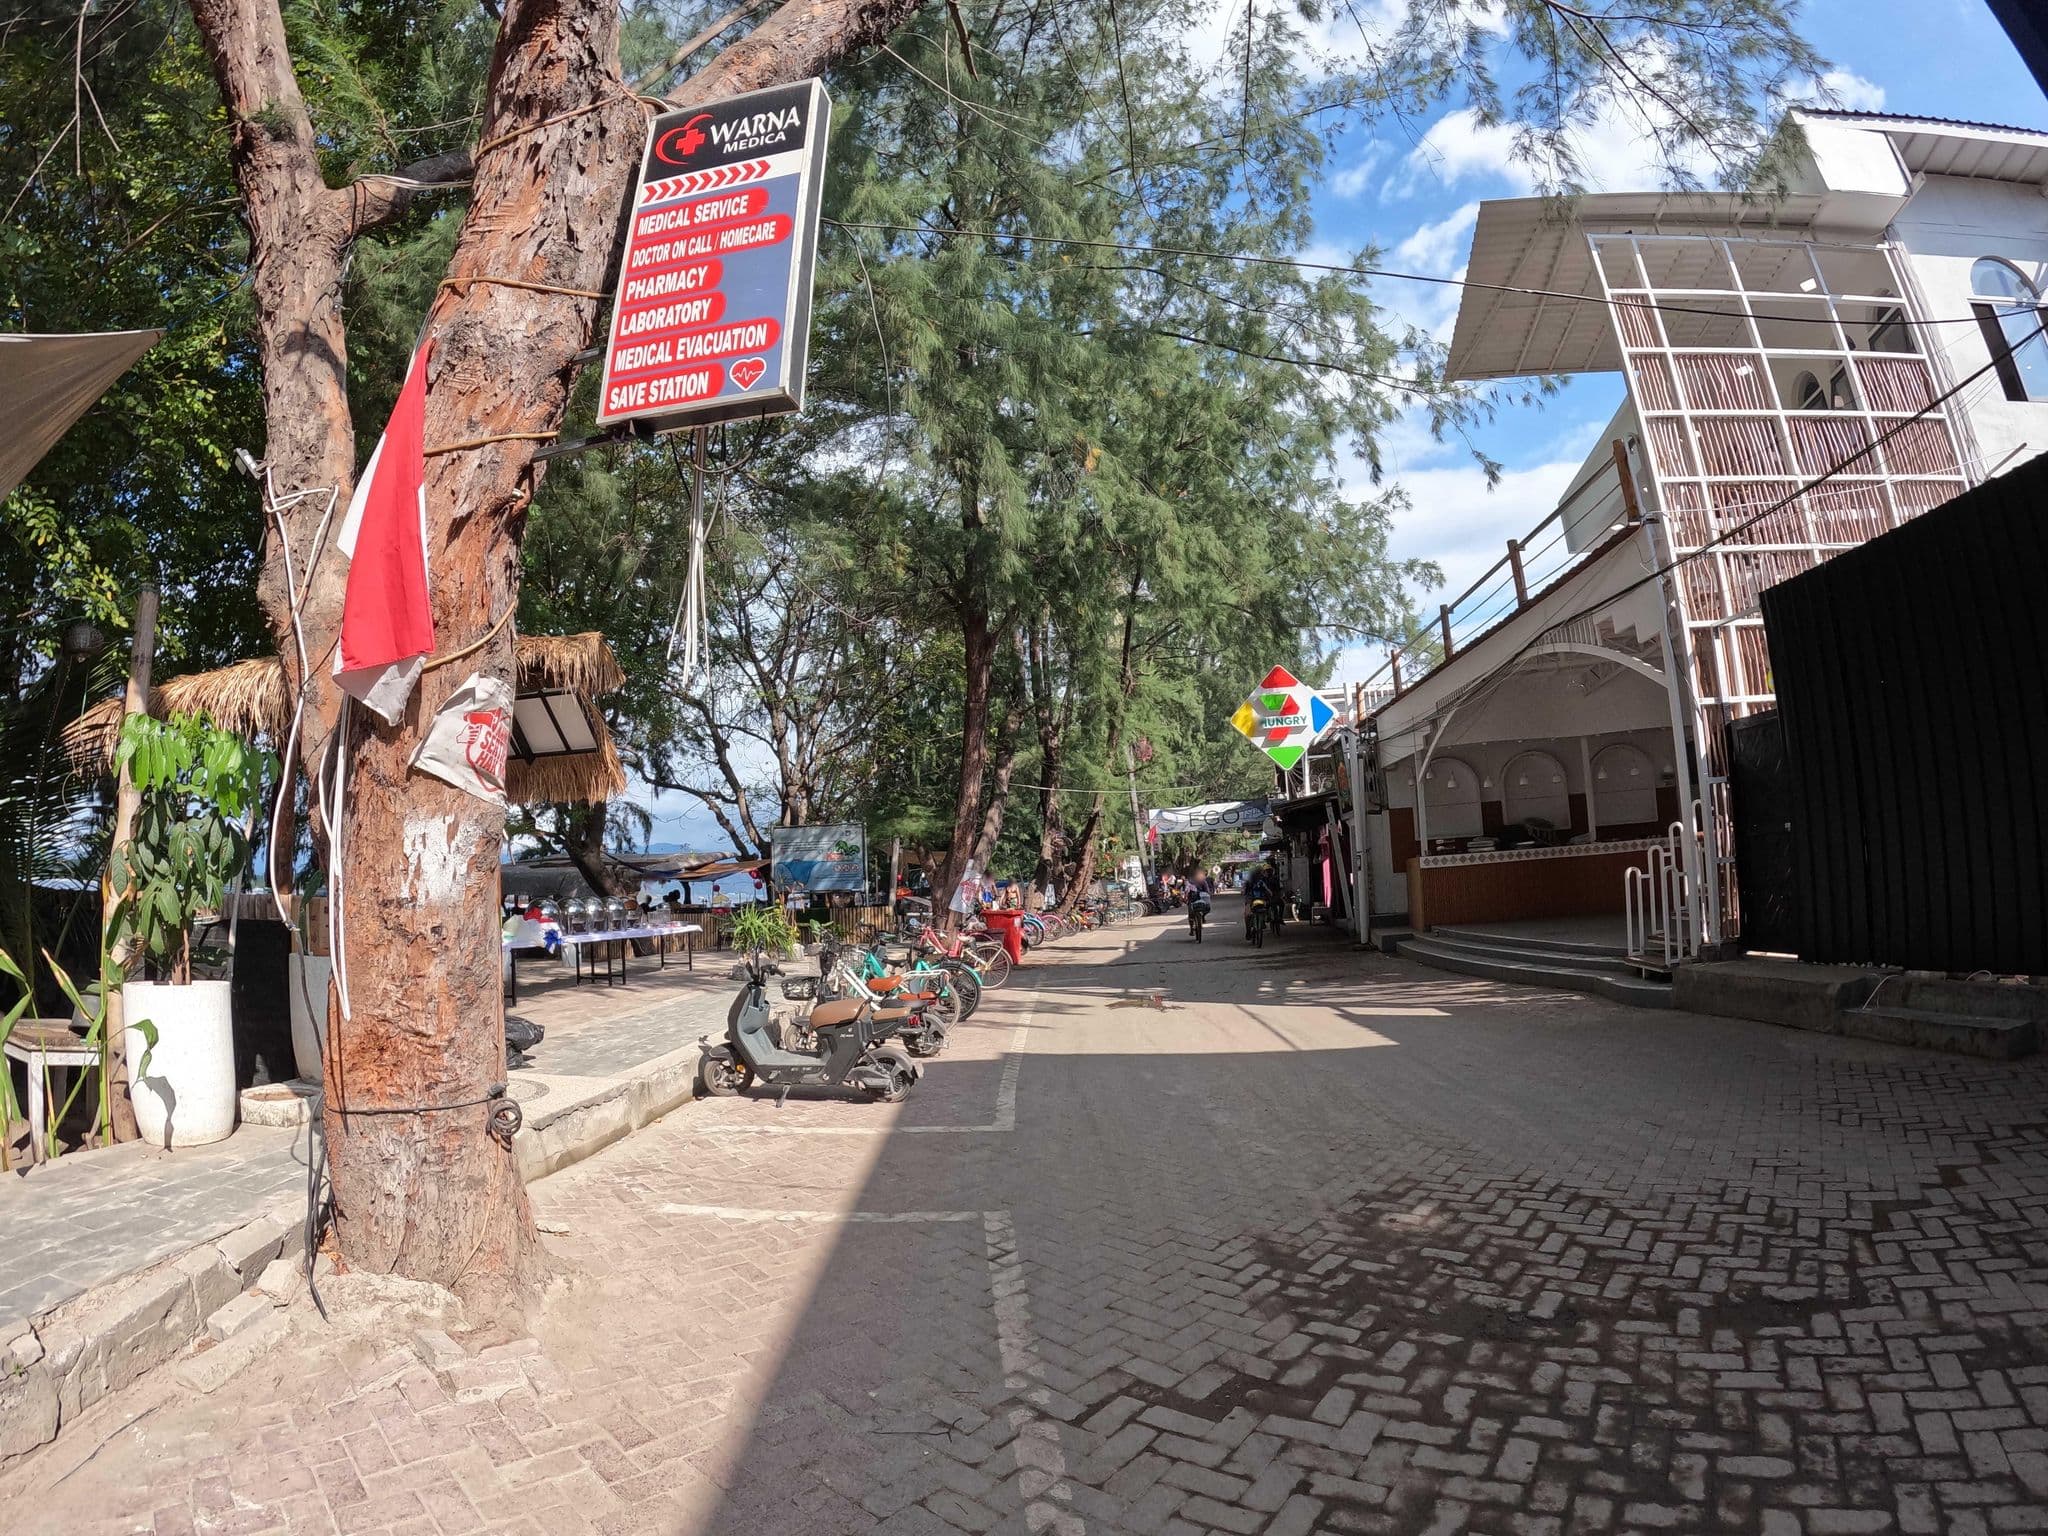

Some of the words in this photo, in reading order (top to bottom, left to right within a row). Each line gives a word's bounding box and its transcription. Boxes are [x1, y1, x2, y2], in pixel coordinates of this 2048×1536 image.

[710, 106, 801, 145] WARNA
[723, 131, 786, 154] MEDICA
[638, 207, 690, 236] MEDICAL
[693, 194, 749, 224] SERVICE
[631, 240, 669, 268] DOCTOR
[671, 237, 686, 260] ON
[688, 231, 712, 256] CALL
[719, 220, 777, 250] HOMECARE
[625, 265, 708, 302] PHARMACY
[619, 298, 712, 337] LABORATORY
[614, 340, 672, 373] MEDICAL
[676, 323, 768, 361] EVACUATION
[609, 382, 647, 411] SAVE
[649, 371, 710, 404] STATION
[1189, 809, 1240, 828] EGO
